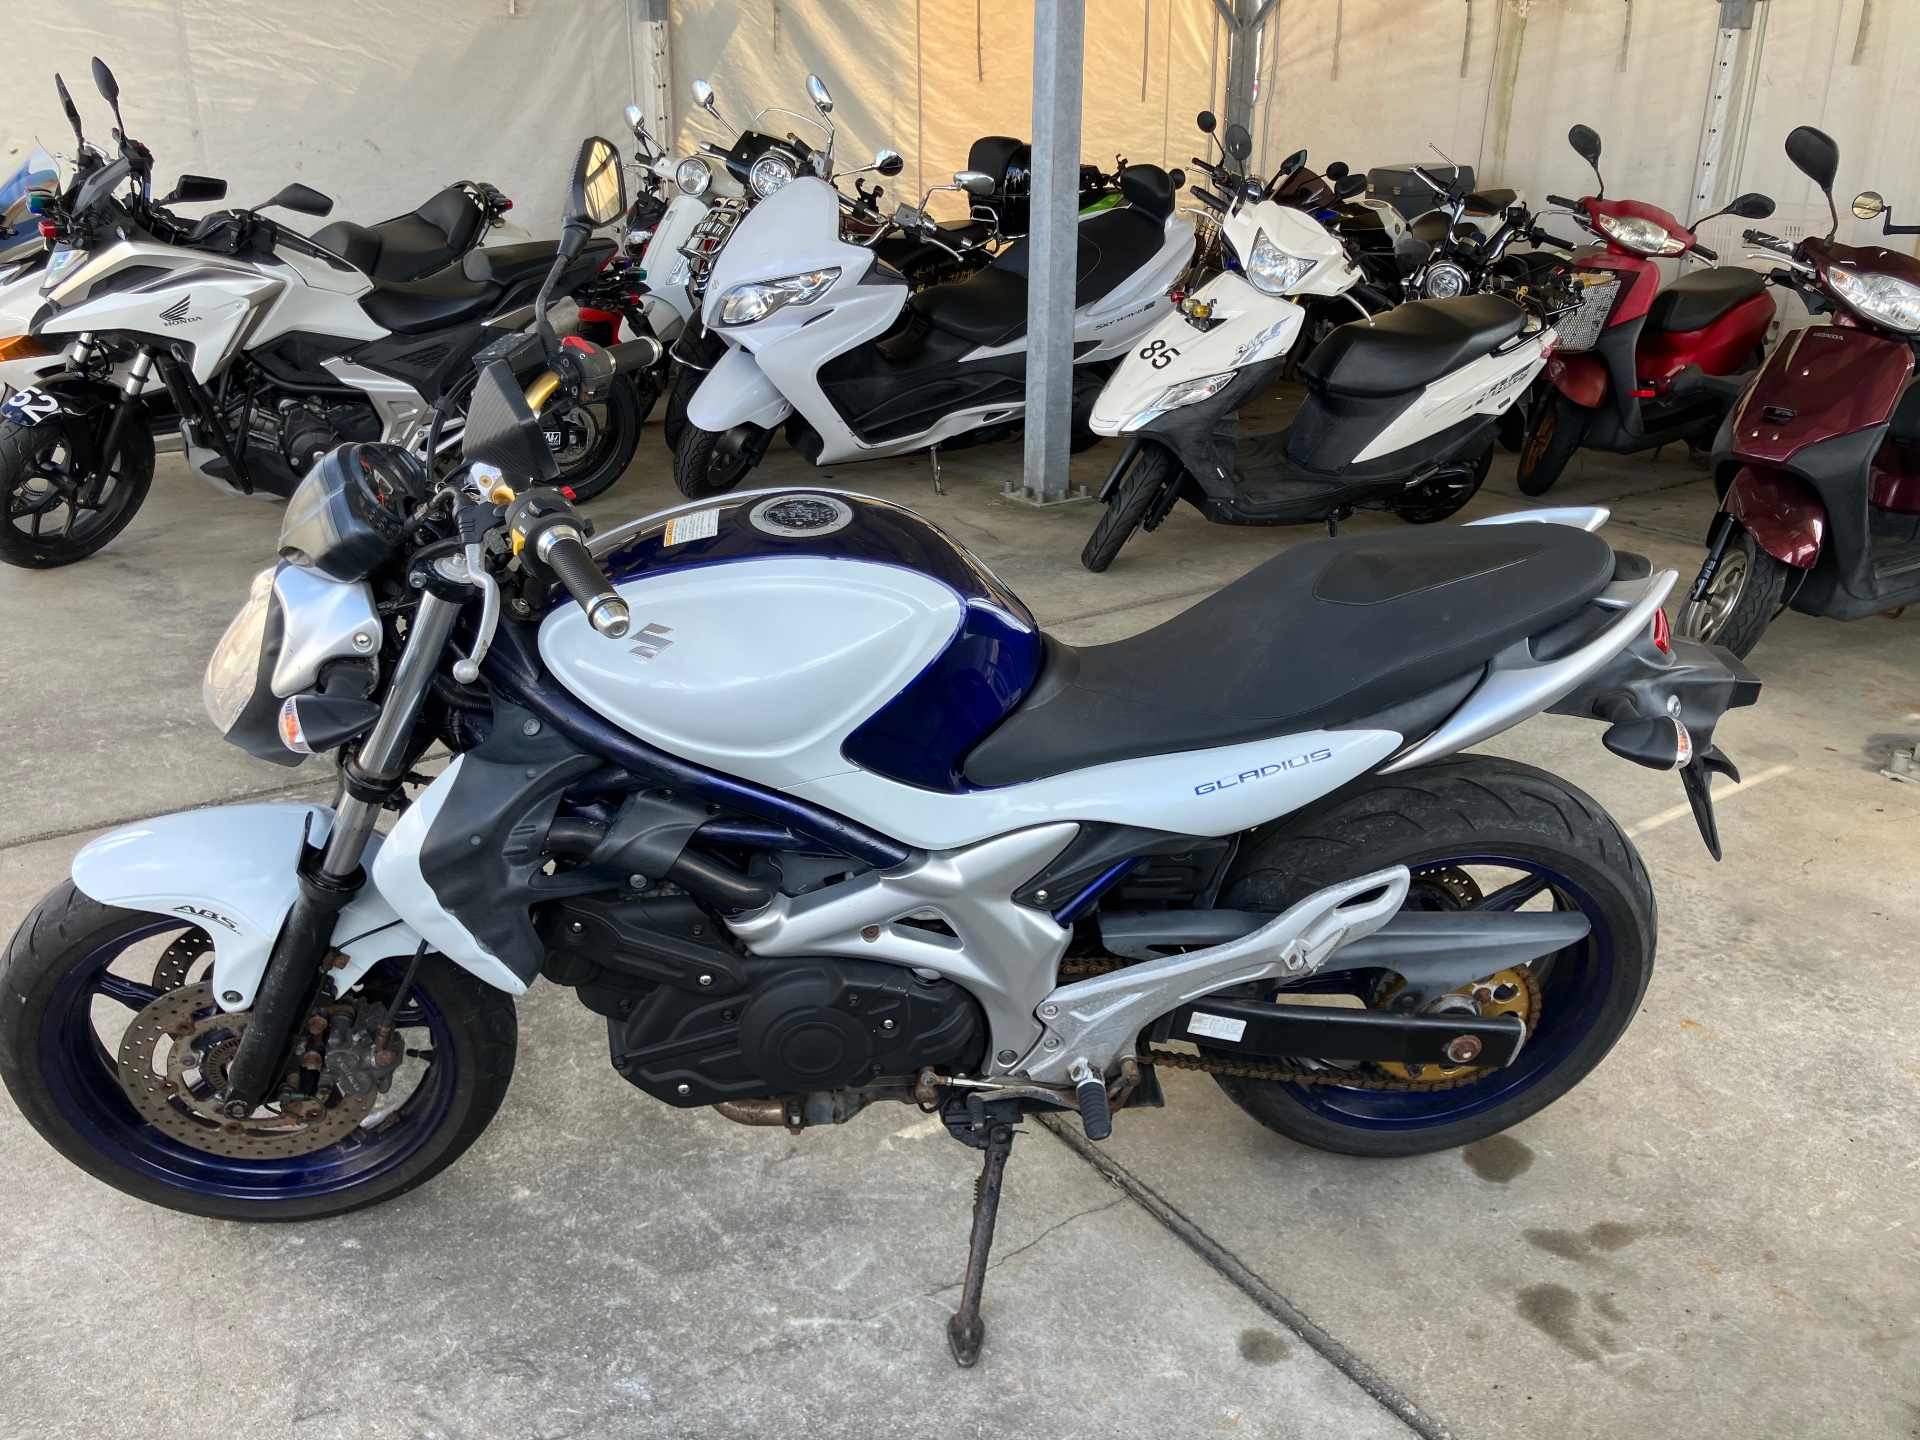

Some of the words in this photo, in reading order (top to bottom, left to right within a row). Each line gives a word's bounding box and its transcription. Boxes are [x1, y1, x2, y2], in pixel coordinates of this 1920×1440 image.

[163, 316, 203, 327] HONDA
[1812, 332, 1844, 341] HONDA
[1139, 339, 1181, 370] 85
[8, 385, 59, 423] 52
[1194, 748, 1332, 796] GLADIUS
[172, 904, 239, 930] ABS
